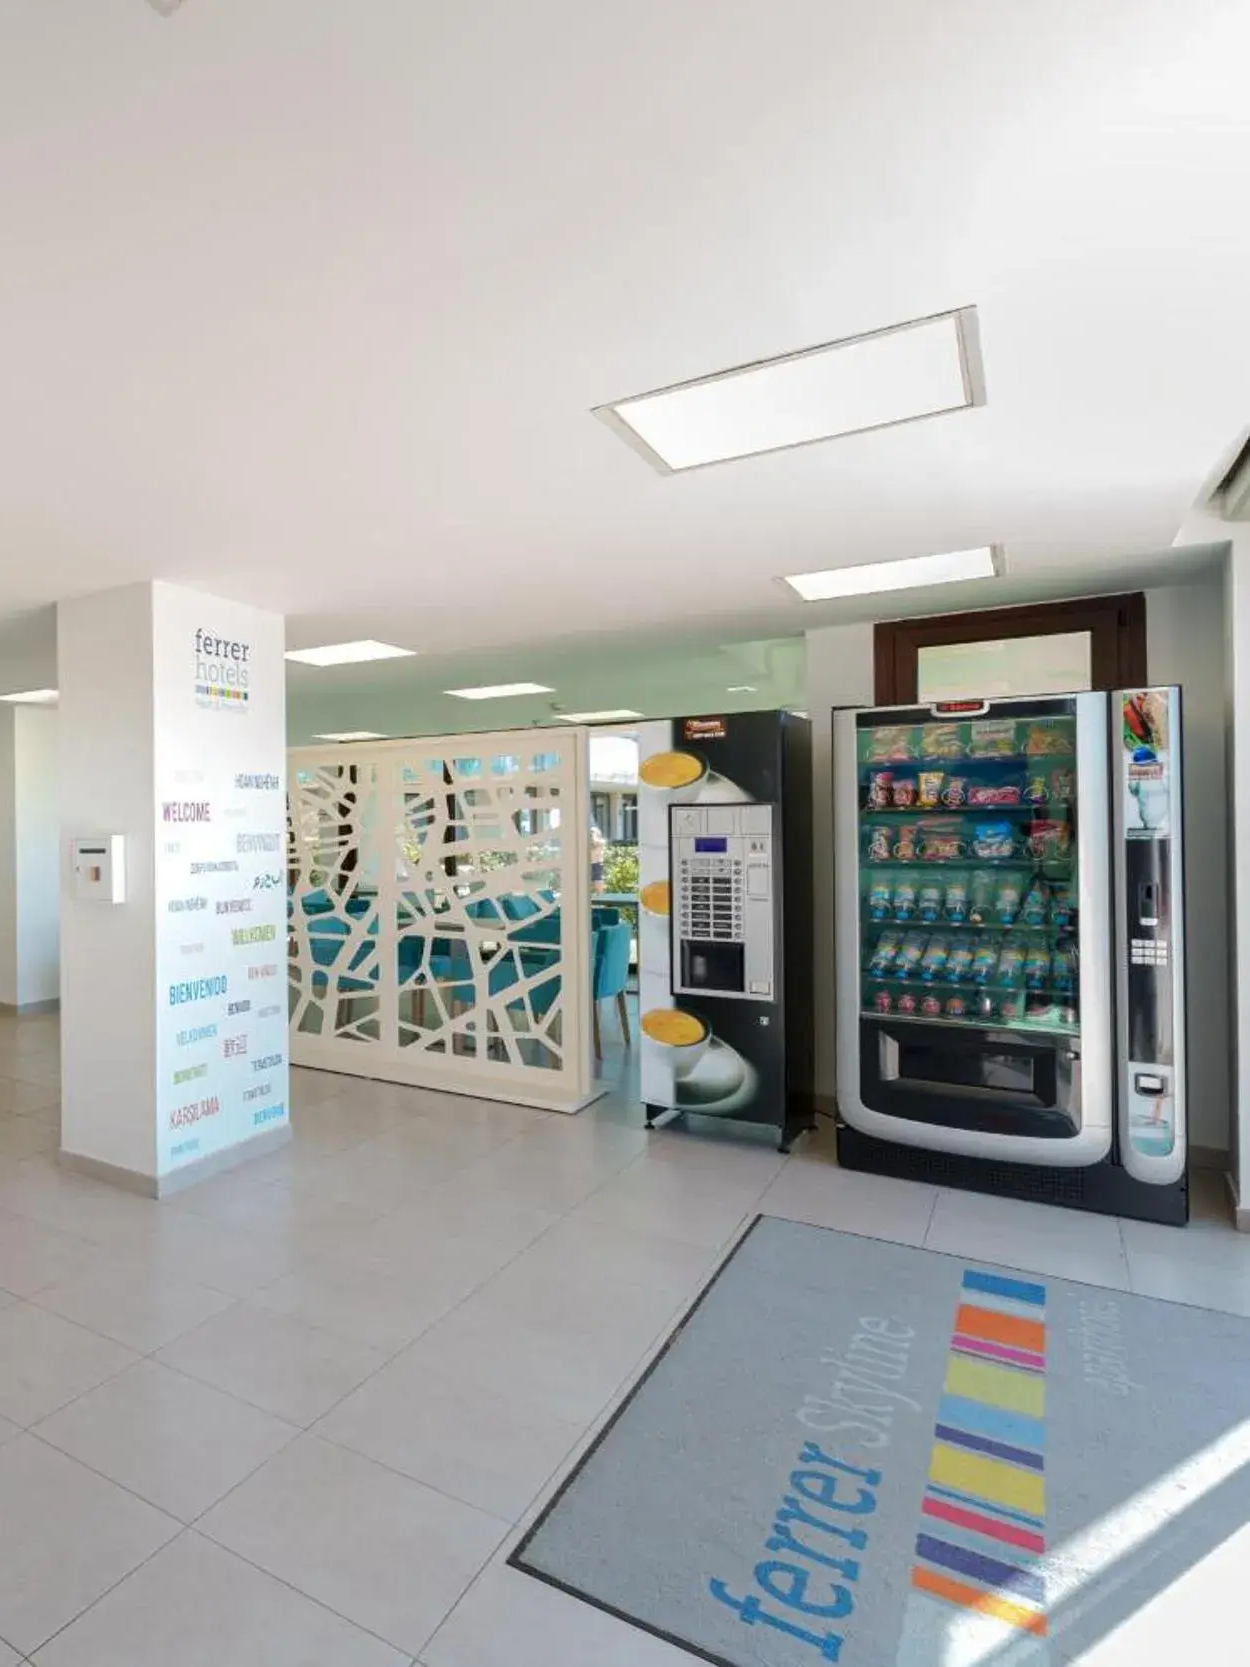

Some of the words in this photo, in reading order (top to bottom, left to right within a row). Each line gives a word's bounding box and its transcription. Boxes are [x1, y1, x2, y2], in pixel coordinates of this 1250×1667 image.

[195, 628, 250, 662] ferrer
[195, 654, 249, 687] hotels
[162, 801, 211, 822] WELCOME
[169, 975, 228, 1005] BIENVENIDO
[709, 1440, 883, 1663] ferrer
[796, 1312, 922, 1449] Skyline
